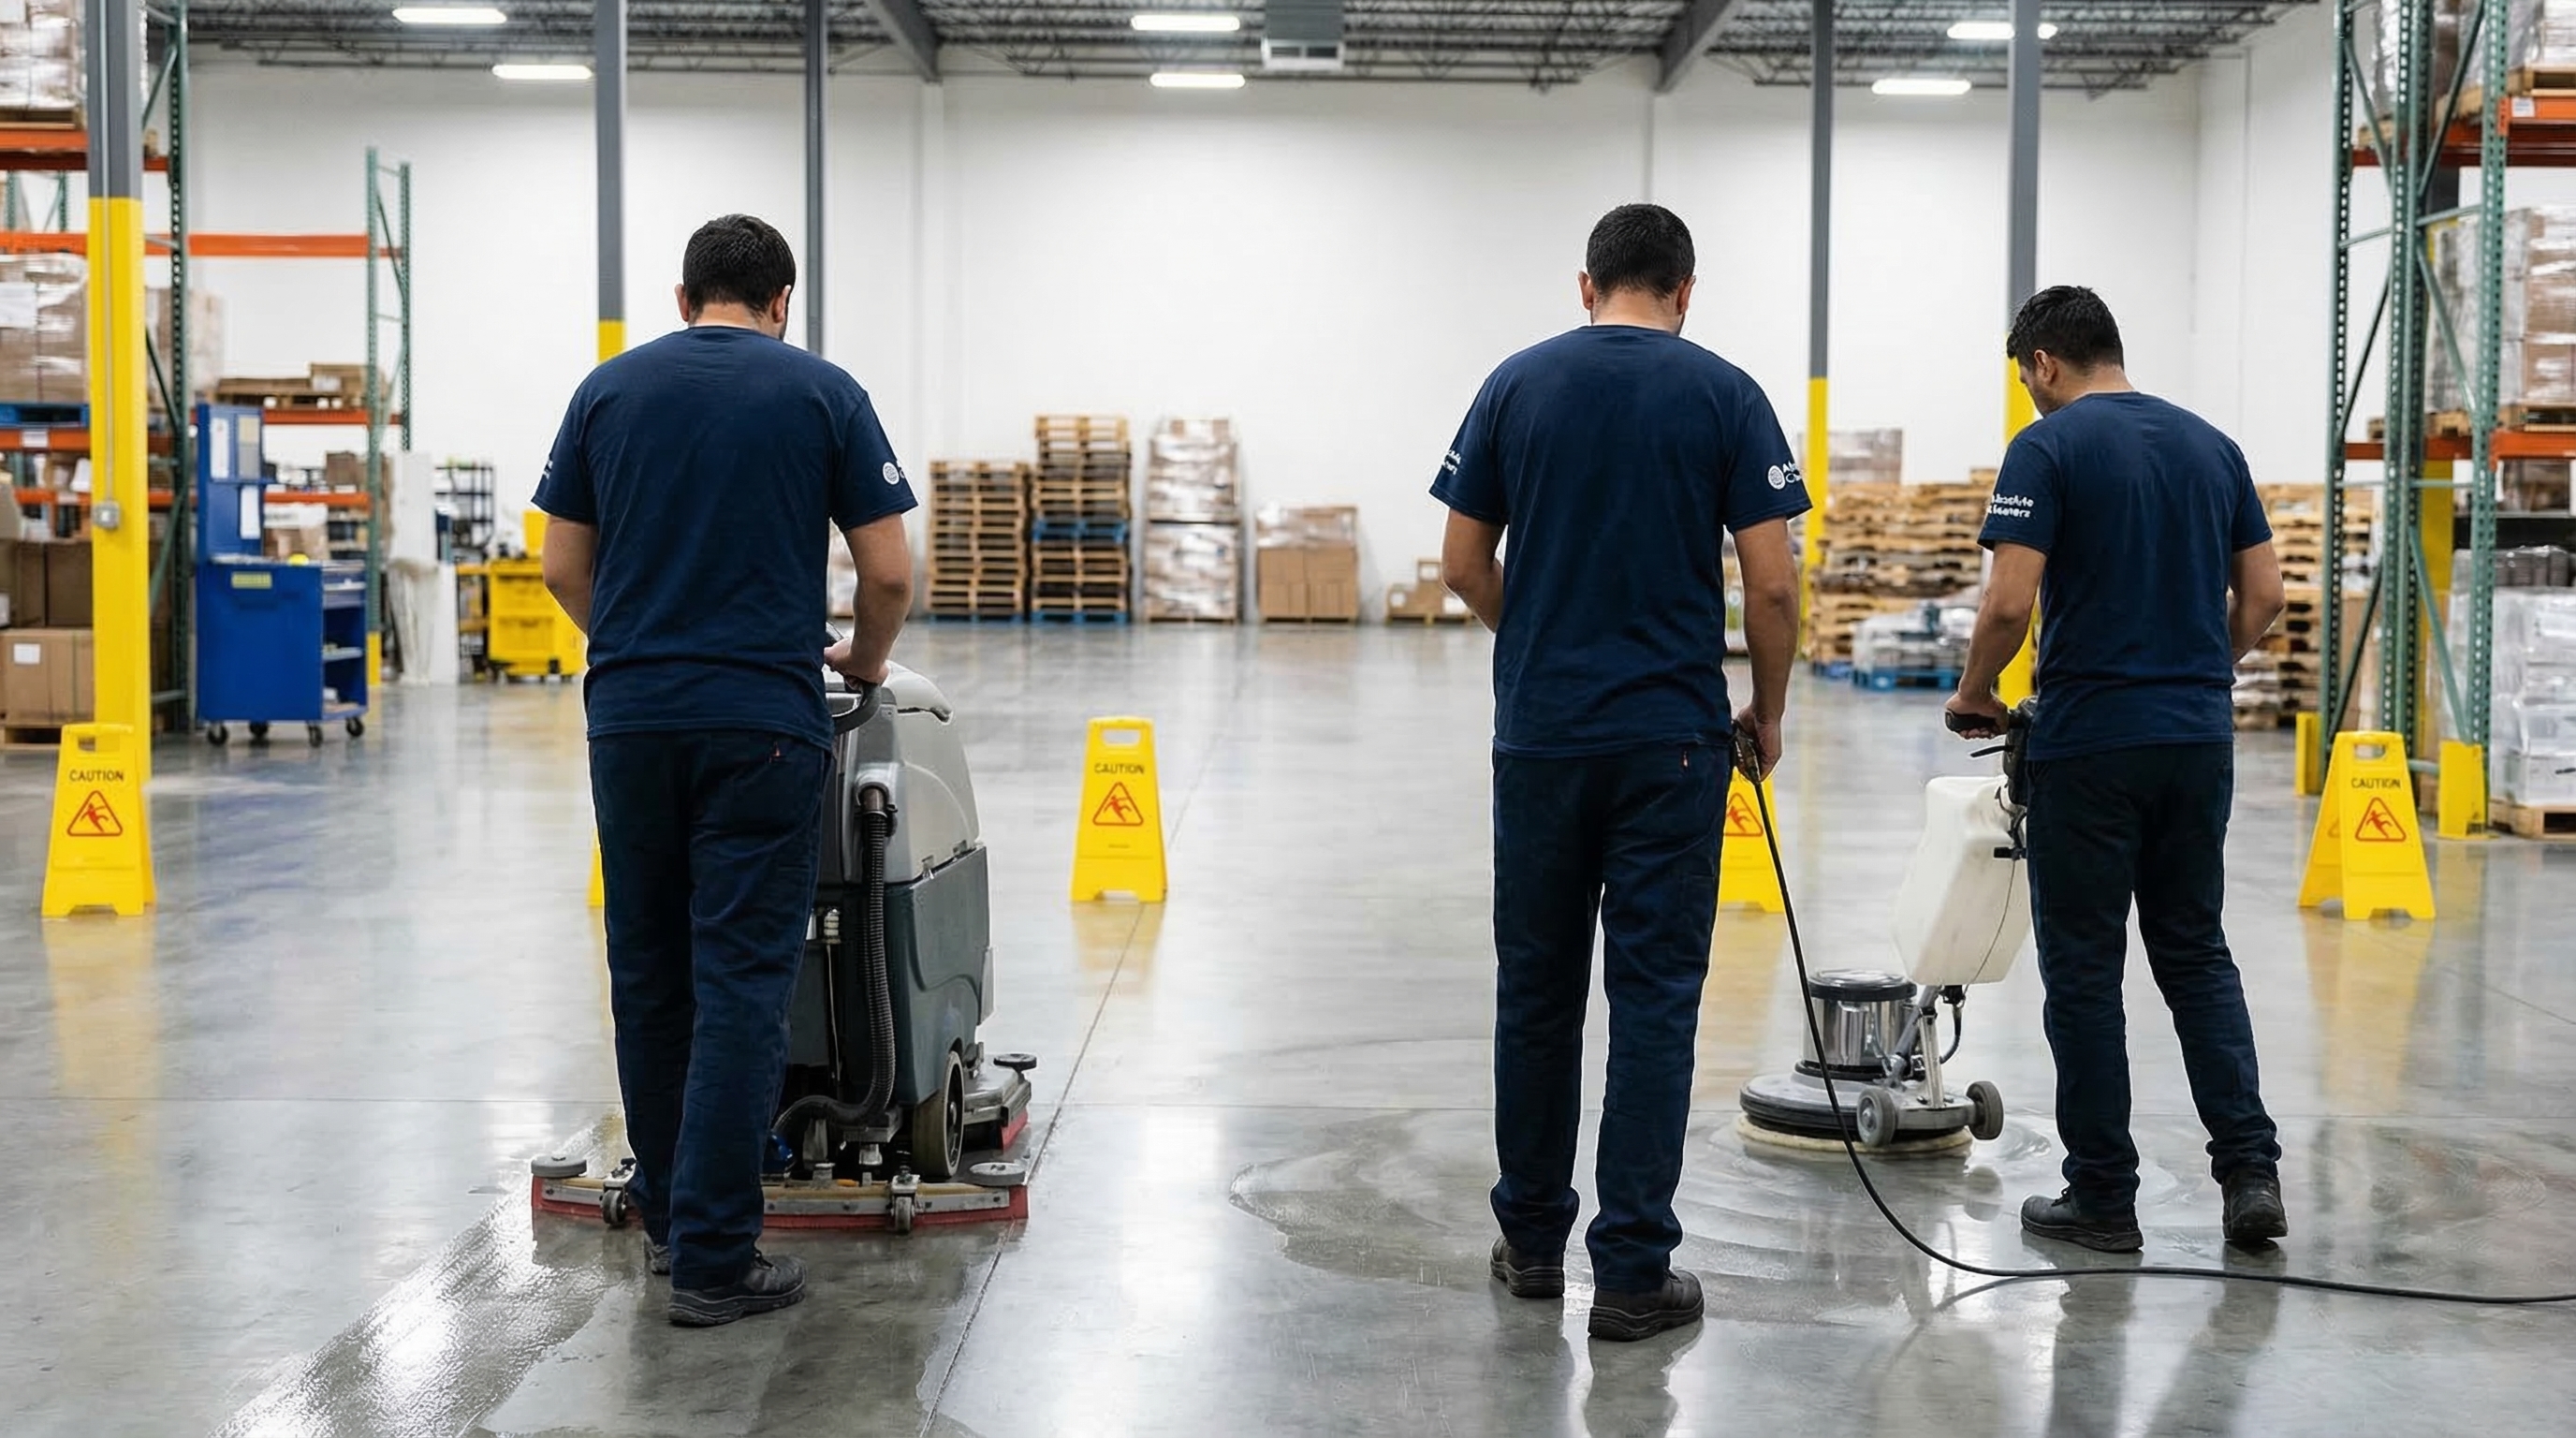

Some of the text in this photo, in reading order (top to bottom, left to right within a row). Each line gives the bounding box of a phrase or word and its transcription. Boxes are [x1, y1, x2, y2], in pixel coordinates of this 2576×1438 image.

[1094, 763, 1145, 774] CAUTION
[69, 770, 124, 782] CAUTION
[2350, 778, 2401, 788] CAUTION
